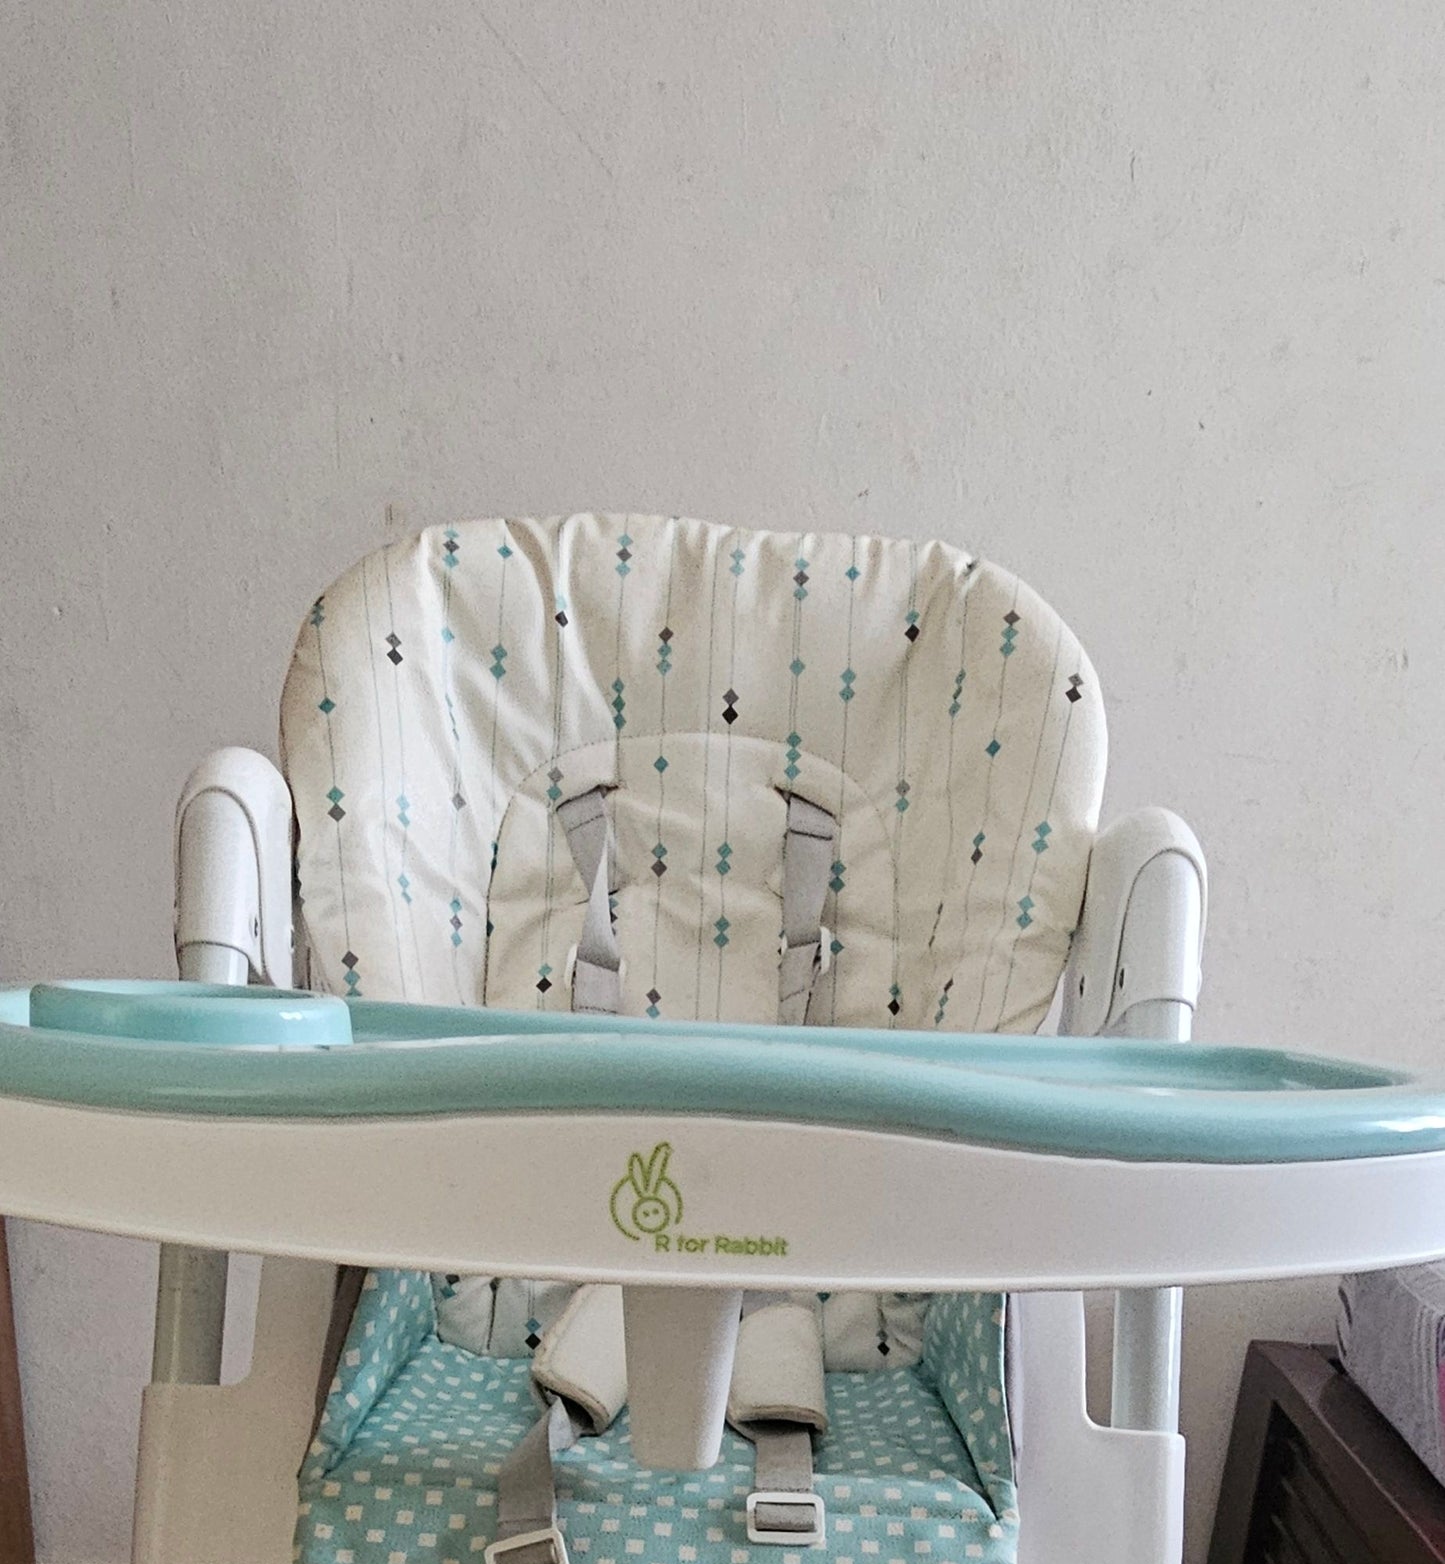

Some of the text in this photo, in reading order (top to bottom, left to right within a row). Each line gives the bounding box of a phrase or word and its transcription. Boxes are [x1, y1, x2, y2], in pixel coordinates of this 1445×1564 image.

[655, 1233, 788, 1255] R for Rabbit
